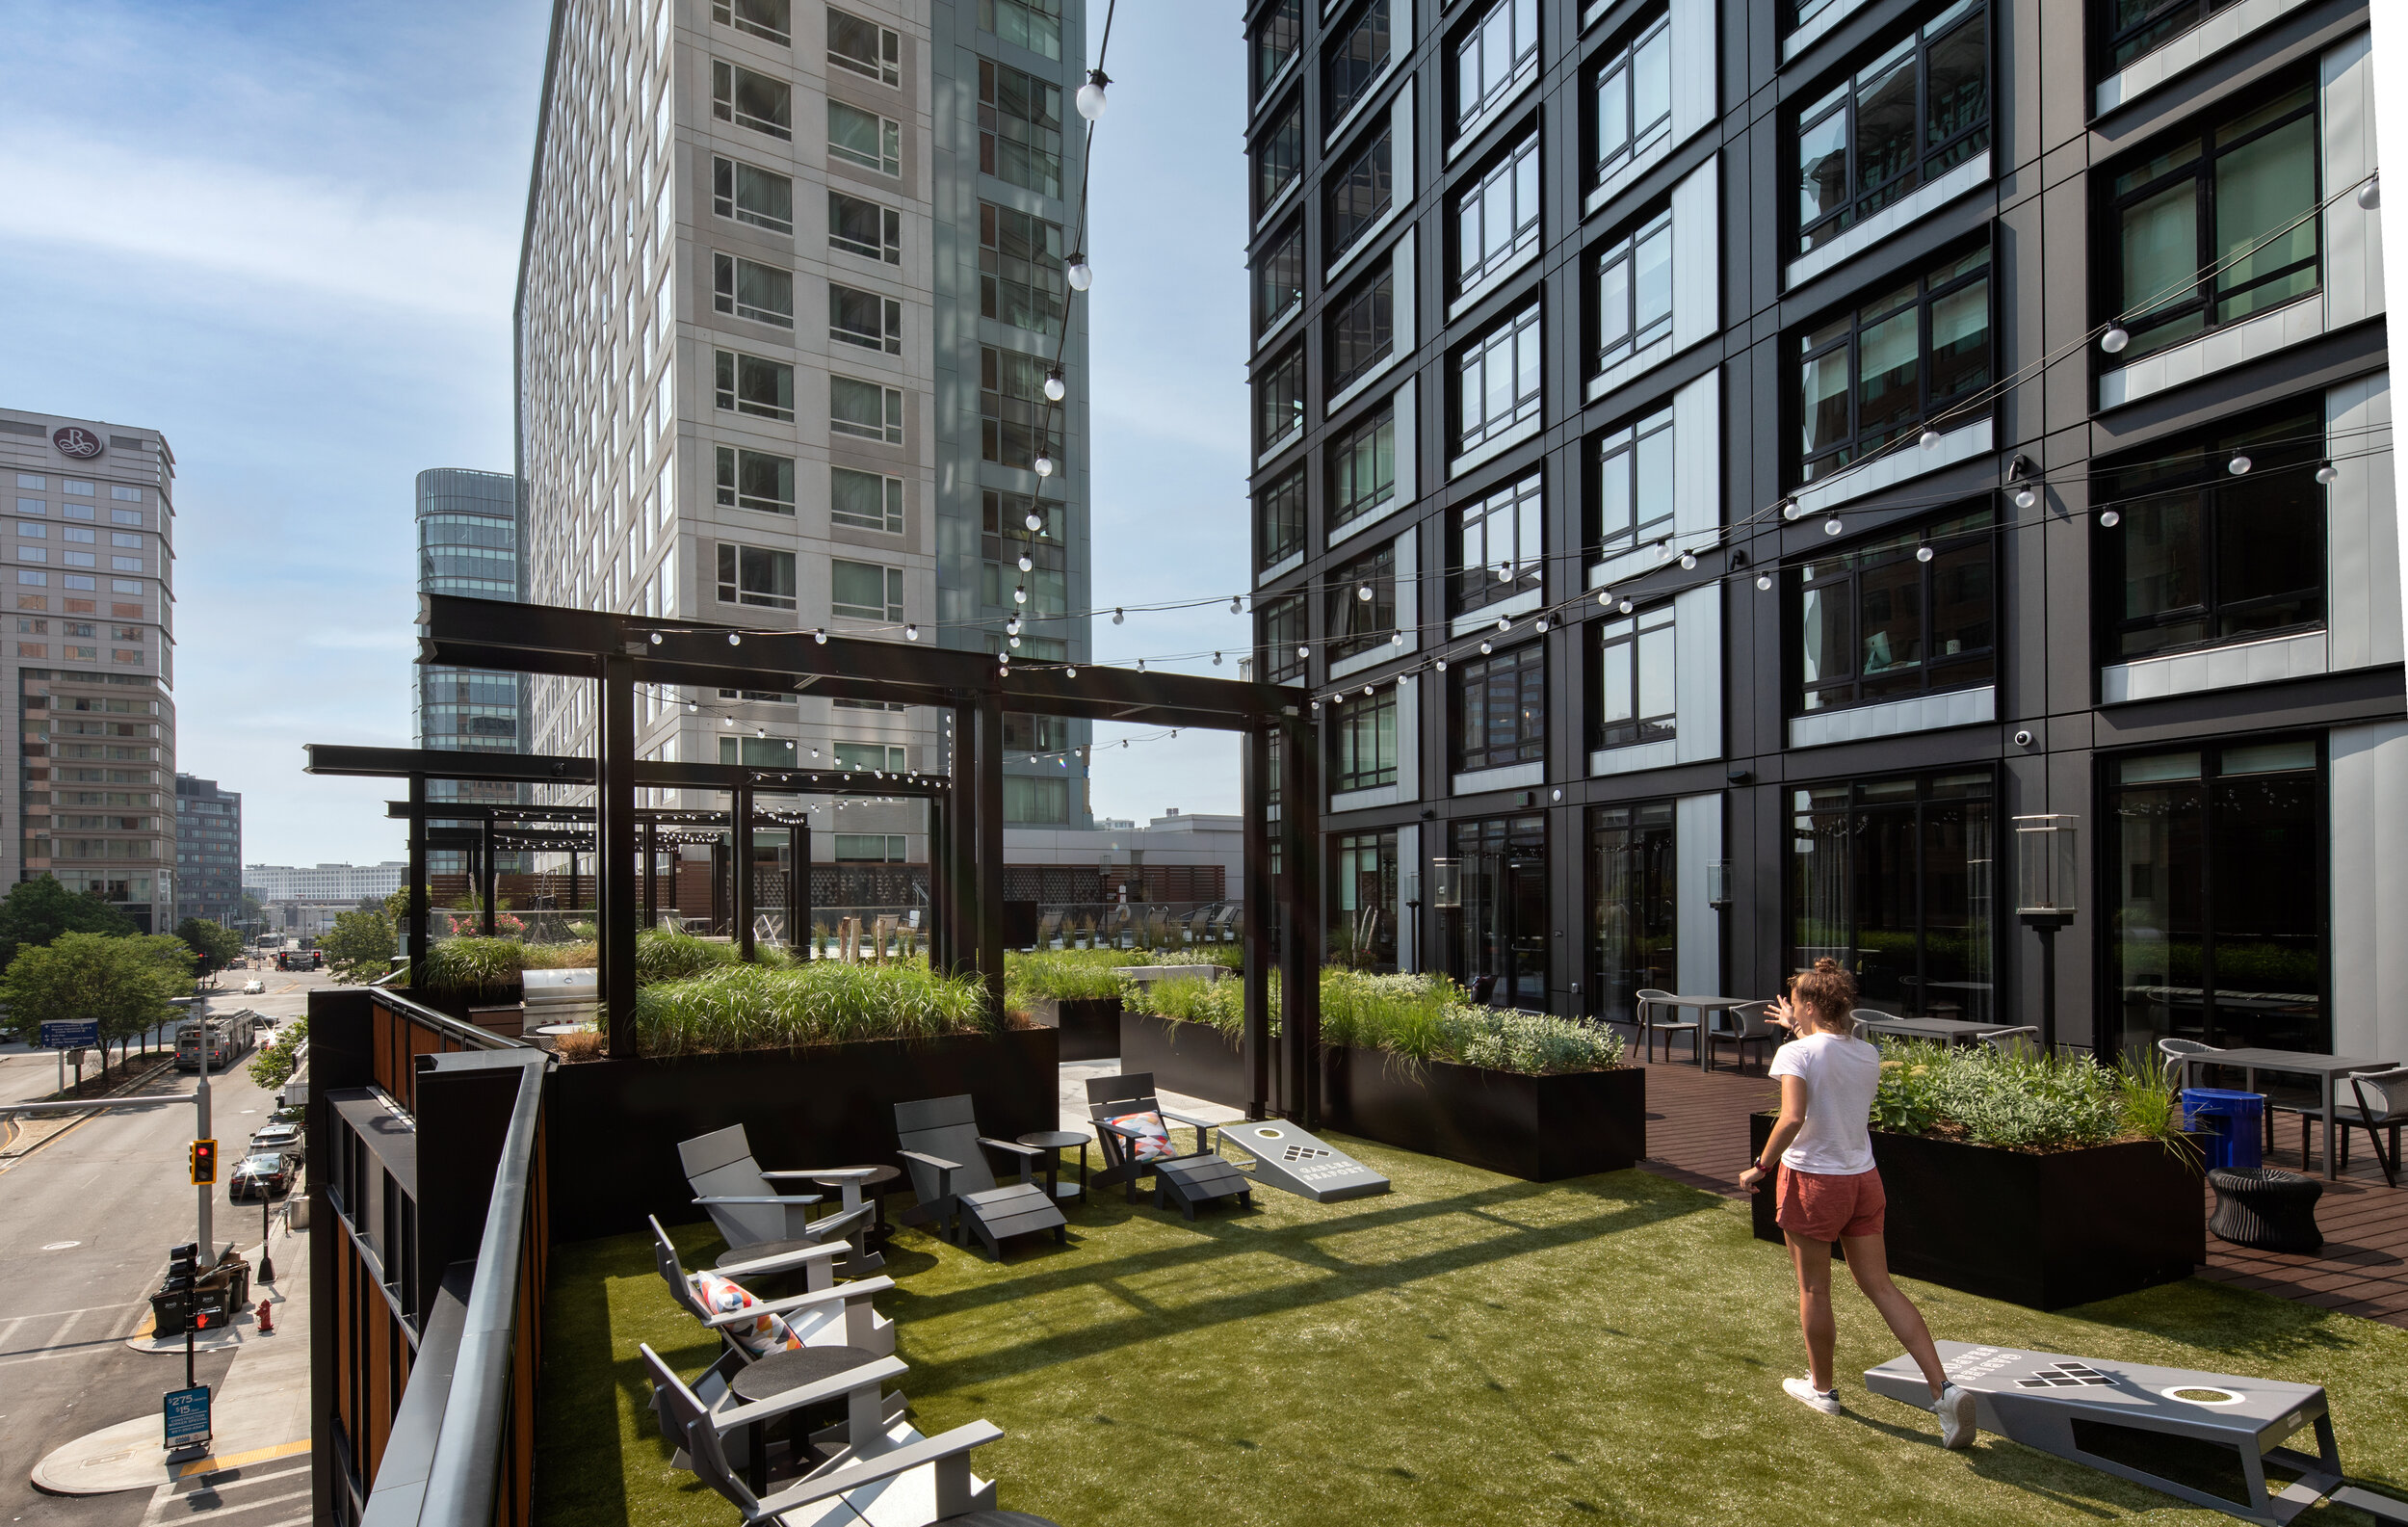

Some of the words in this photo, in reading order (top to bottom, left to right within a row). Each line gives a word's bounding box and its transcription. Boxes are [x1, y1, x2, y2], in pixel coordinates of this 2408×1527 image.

[1299, 1161, 1352, 1173] GABLES
[1303, 1167, 1364, 1181] SEAPORT
[1951, 1354, 2022, 1381] GABLES
[169, 1395, 193, 1406] $275
[175, 1406, 190, 1414] $15
